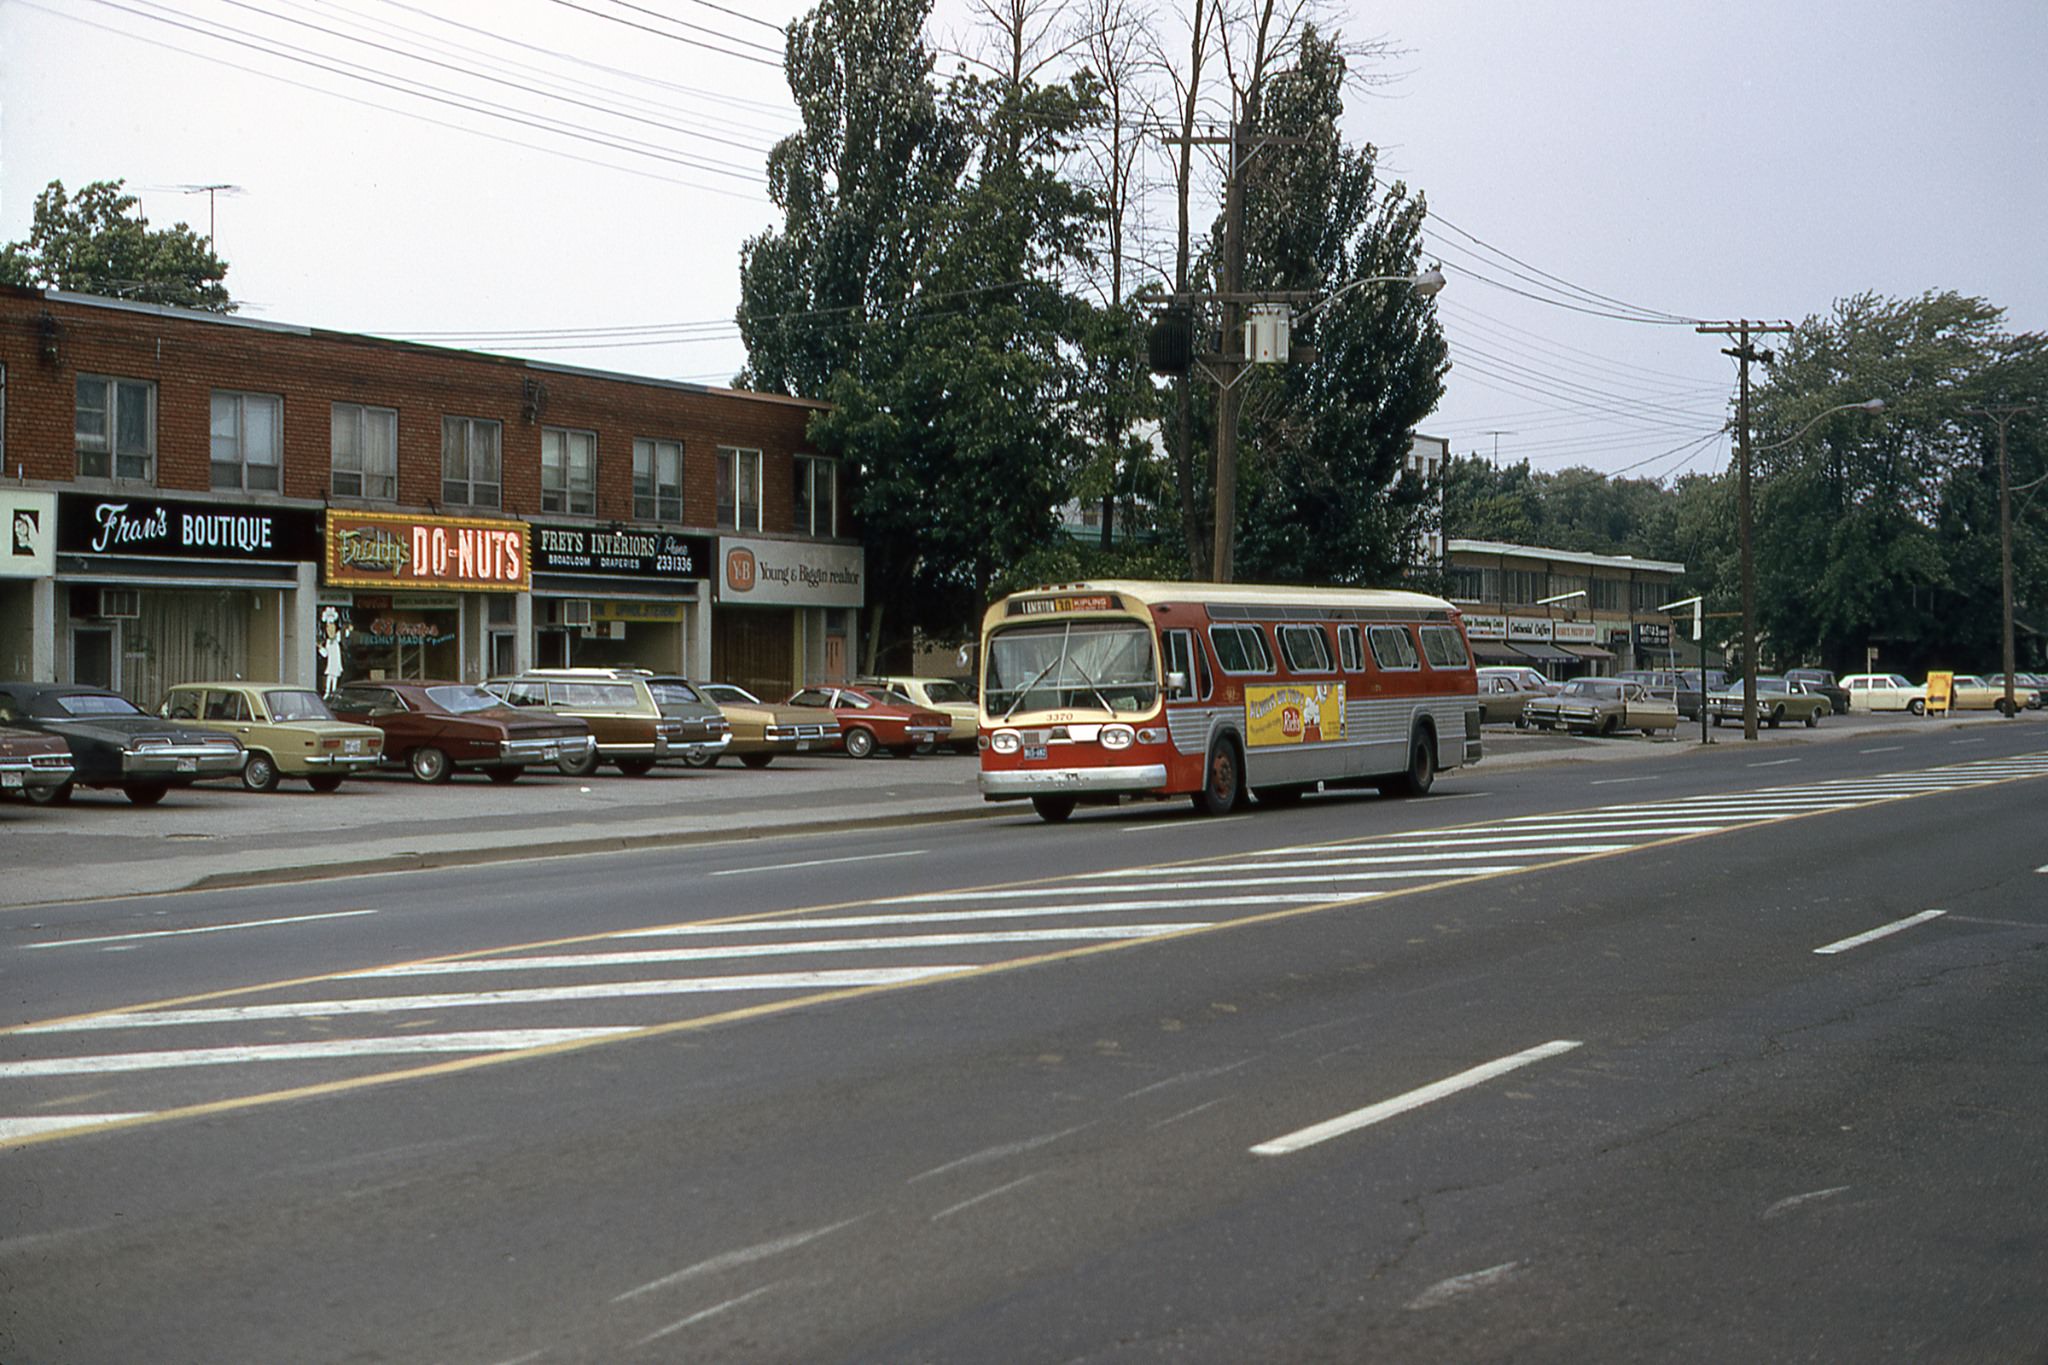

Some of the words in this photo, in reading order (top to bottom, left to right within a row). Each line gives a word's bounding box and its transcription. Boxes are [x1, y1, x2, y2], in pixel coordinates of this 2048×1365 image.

[92, 504, 167, 551] Fran's
[183, 514, 272, 551] BOUTIQUE
[337, 529, 410, 577] Freddy's
[413, 527, 520, 580] DO-NUTS
[541, 530, 583, 553] FREY'S
[591, 533, 655, 557] INTERIORS
[548, 554, 591, 567] BROADLOOM
[656, 555, 693, 573] 2331336
[759, 561, 790, 587] Young
[799, 564, 828, 588] Biggin
[1073, 597, 1107, 606] KIPLING
[1046, 713, 1073, 721] 3370
